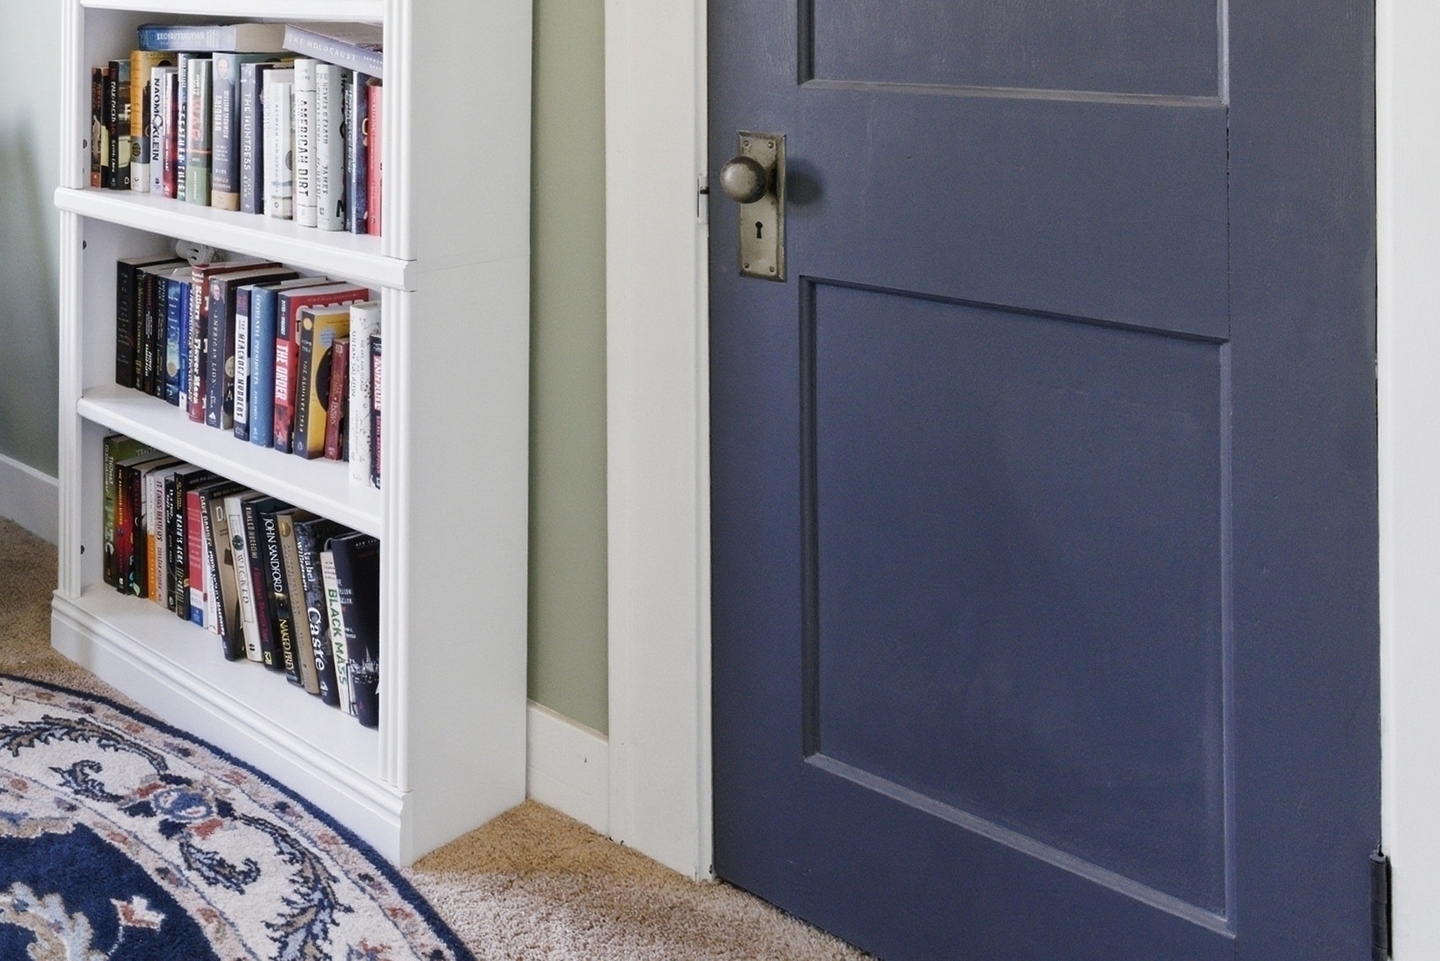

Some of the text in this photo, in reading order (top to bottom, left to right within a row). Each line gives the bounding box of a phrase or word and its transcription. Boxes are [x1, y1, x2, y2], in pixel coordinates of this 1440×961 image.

[288, 35, 357, 61] THE HOLOCAUST
[152, 78, 161, 161] NAOMI KLEIN
[214, 95, 223, 132] SHERMAN
[244, 93, 252, 112] THE
[298, 100, 309, 197] AMERICAN DIRT
[193, 338, 201, 375] Flower
[237, 333, 247, 376] MENENDEZ
[277, 344, 289, 366] THE
[193, 376, 201, 404] Moon
[235, 378, 245, 417] MURDERS
[275, 368, 288, 401] ORDER
[200, 496, 208, 514] DAVE
[157, 531, 163, 542] US
[263, 518, 283, 593] JOHN SANDFORD
[237, 553, 250, 604] WICKED
[297, 540, 308, 592] Wilkerson
[306, 551, 316, 583] Isabel
[278, 618, 295, 671] NAKED PREY
[307, 606, 326, 671] Caste
[327, 588, 347, 685] BLACK MASS
